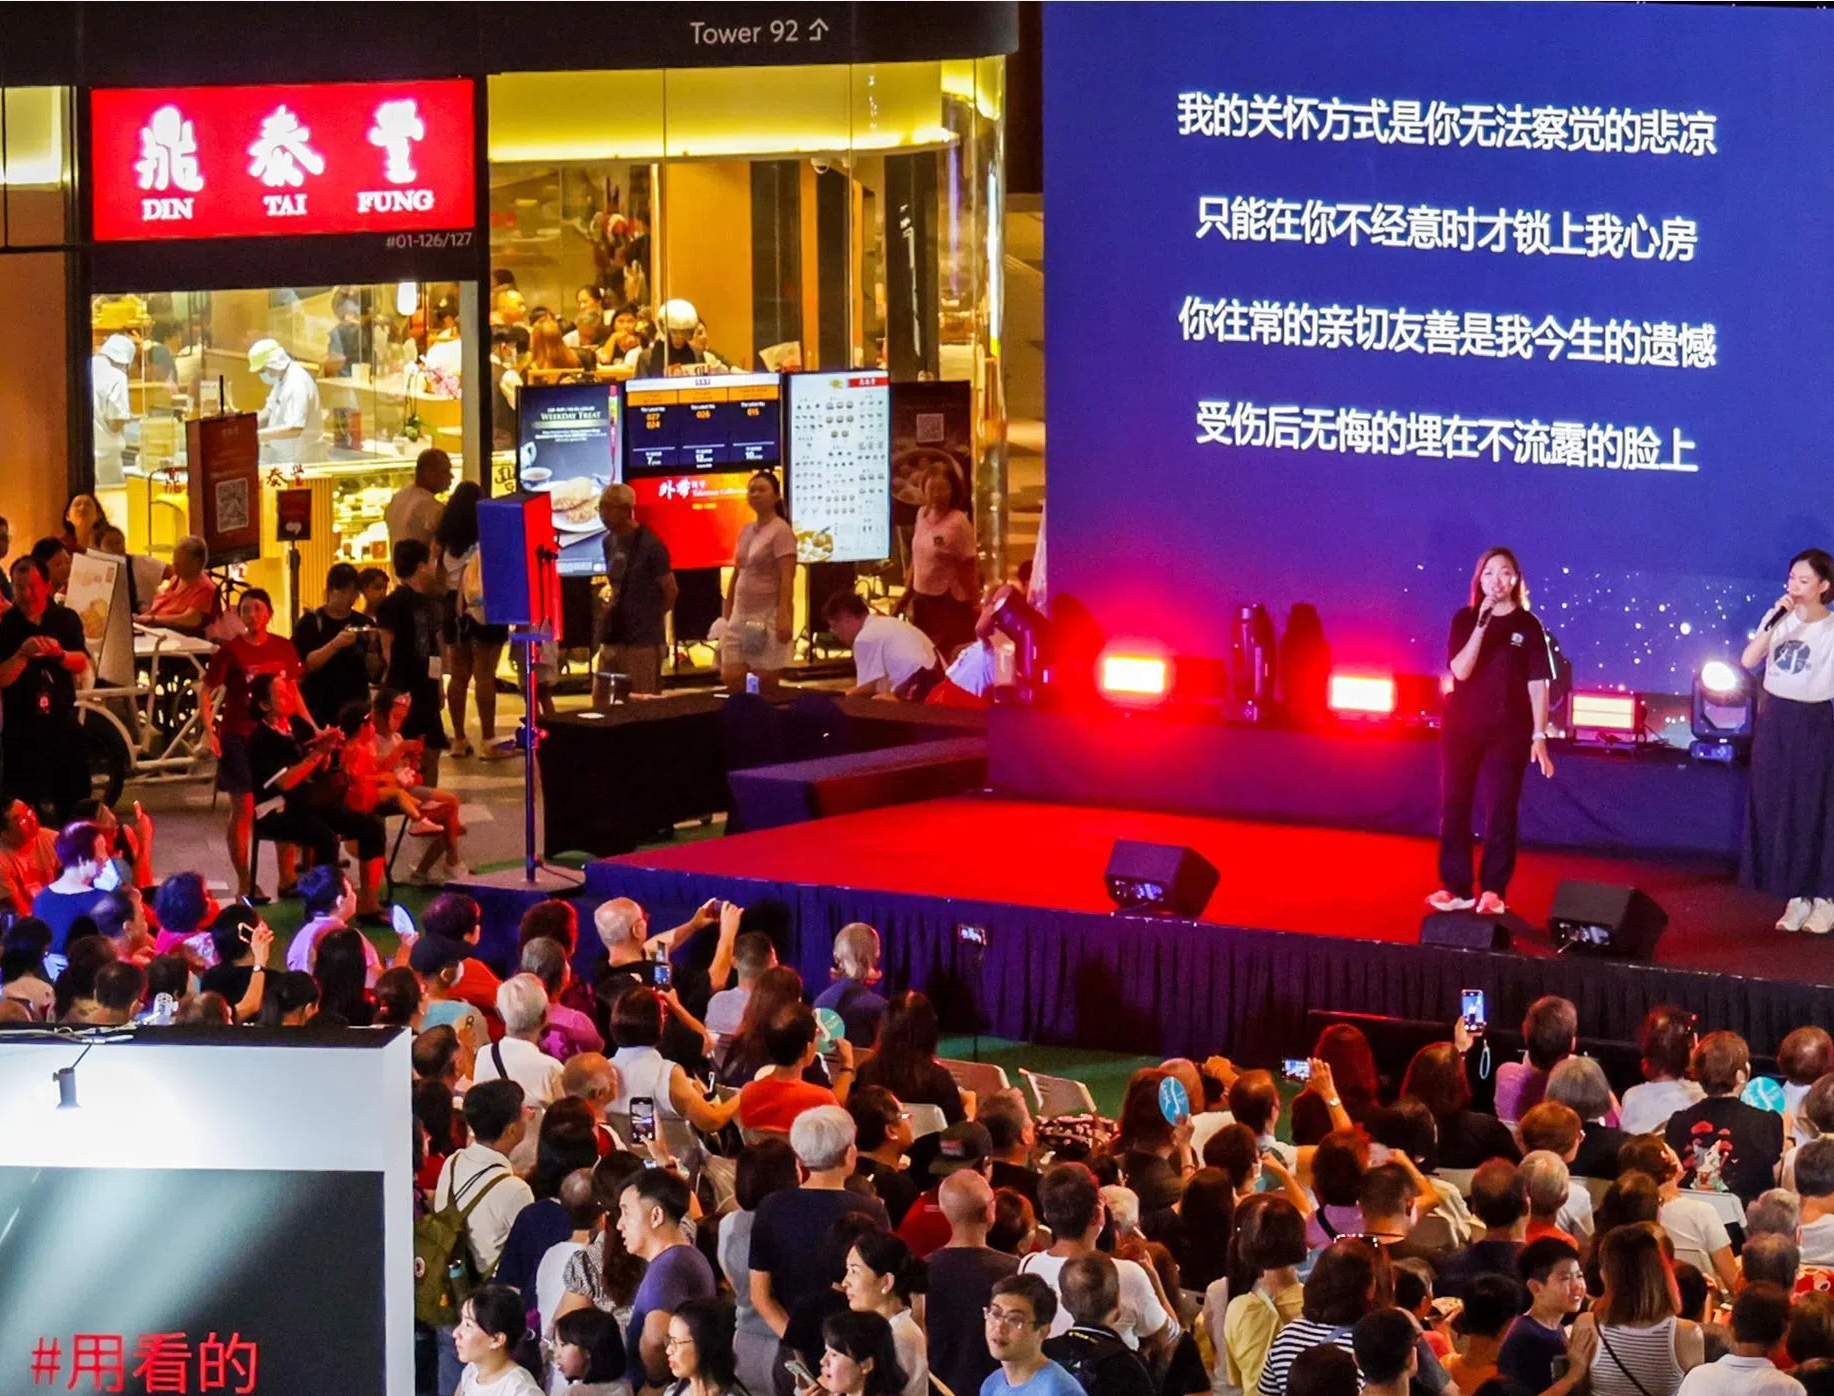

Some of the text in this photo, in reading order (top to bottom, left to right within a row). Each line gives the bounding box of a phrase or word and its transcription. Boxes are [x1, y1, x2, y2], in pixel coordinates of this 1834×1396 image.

[691, 20, 800, 45] Tower 92
[1177, 91, 1717, 157] 我的关怀方式是你无法察觉的悲凉
[142, 189, 435, 221] DIN TAI FUNG
[1195, 195, 1698, 263] 只能在你不经意时才锁上我心房
[384, 231, 473, 250] #01-126/127
[1178, 296, 1717, 370] 你往常的亲切友善是我今生的遗憾
[1195, 399, 1699, 474] 受伤后无悔的埋在不流露的脸上
[30, 1330, 260, 1396] #用看的
